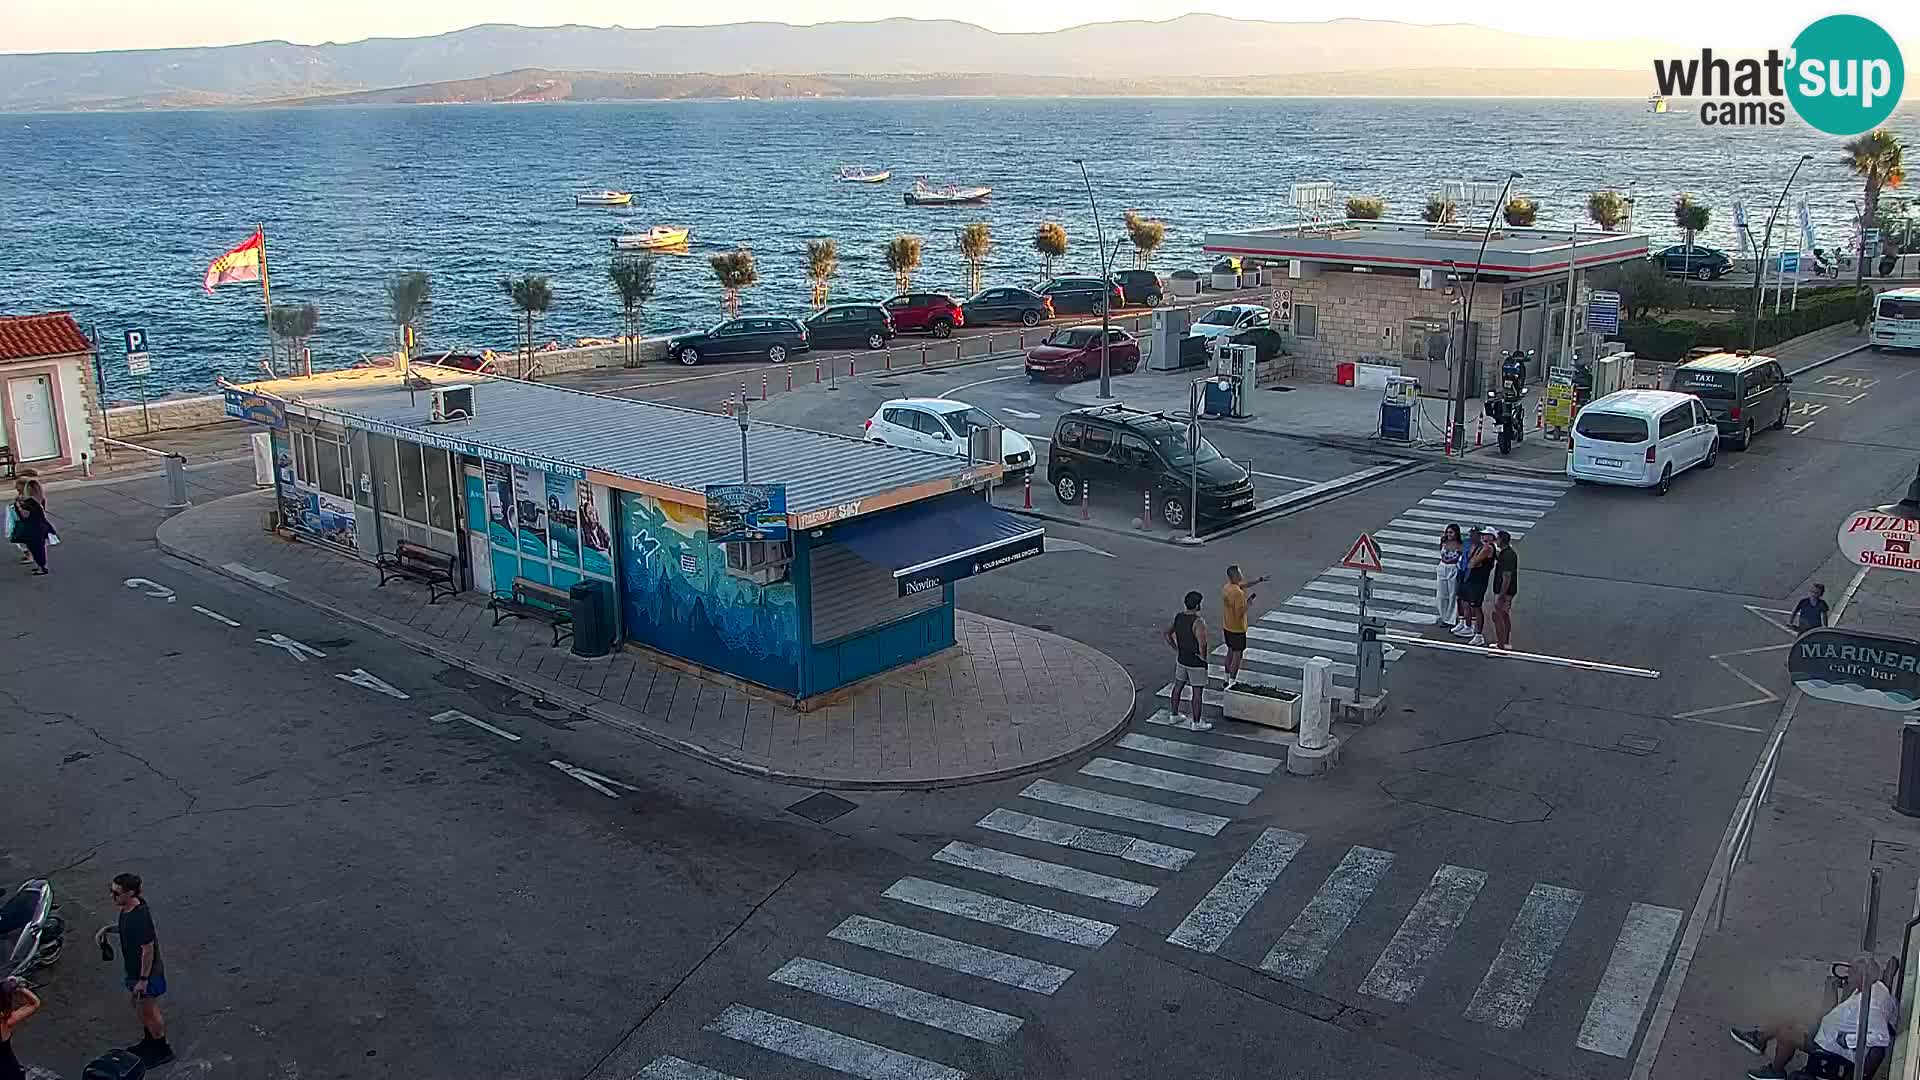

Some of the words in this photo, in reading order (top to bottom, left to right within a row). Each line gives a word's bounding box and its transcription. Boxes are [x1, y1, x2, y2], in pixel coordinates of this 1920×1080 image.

[129, 332, 142, 351] P
[1695, 374, 1714, 383] TAXI
[437, 440, 468, 453] POSTAJA
[478, 447, 493, 459] BUS
[494, 450, 526, 465] STATION
[527, 458, 554, 472] TICKET
[555, 464, 582, 478] OFFICE
[1848, 516, 1920, 534] PIZZE
[1829, 663, 1866, 676] caffe
[1871, 667, 1897, 681] bar
